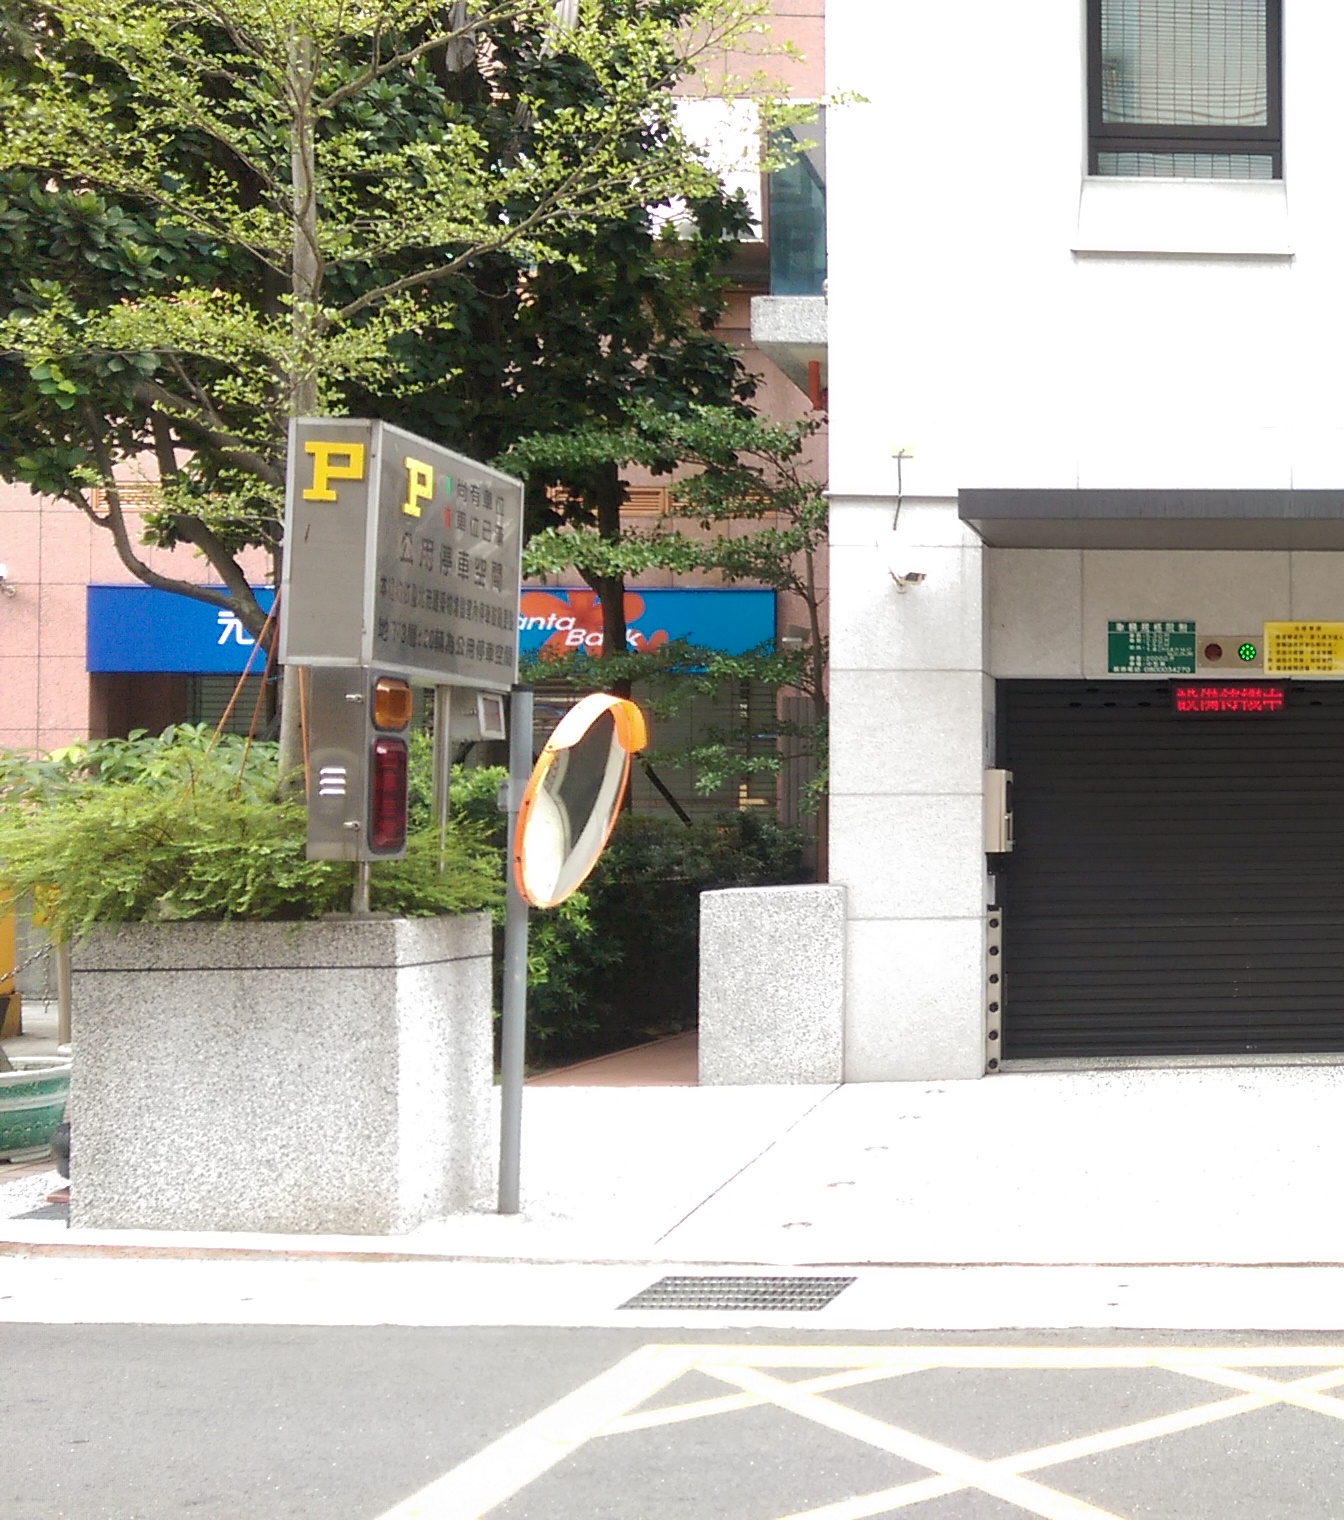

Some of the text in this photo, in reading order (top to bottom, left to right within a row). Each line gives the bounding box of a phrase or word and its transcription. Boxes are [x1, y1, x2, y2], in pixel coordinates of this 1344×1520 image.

[302, 441, 366, 502] P
[401, 456, 434, 518] P
[400, 531, 503, 593] 公用停車空間
[217, 611, 255, 645] 元
[566, 628, 642, 647] Bak
